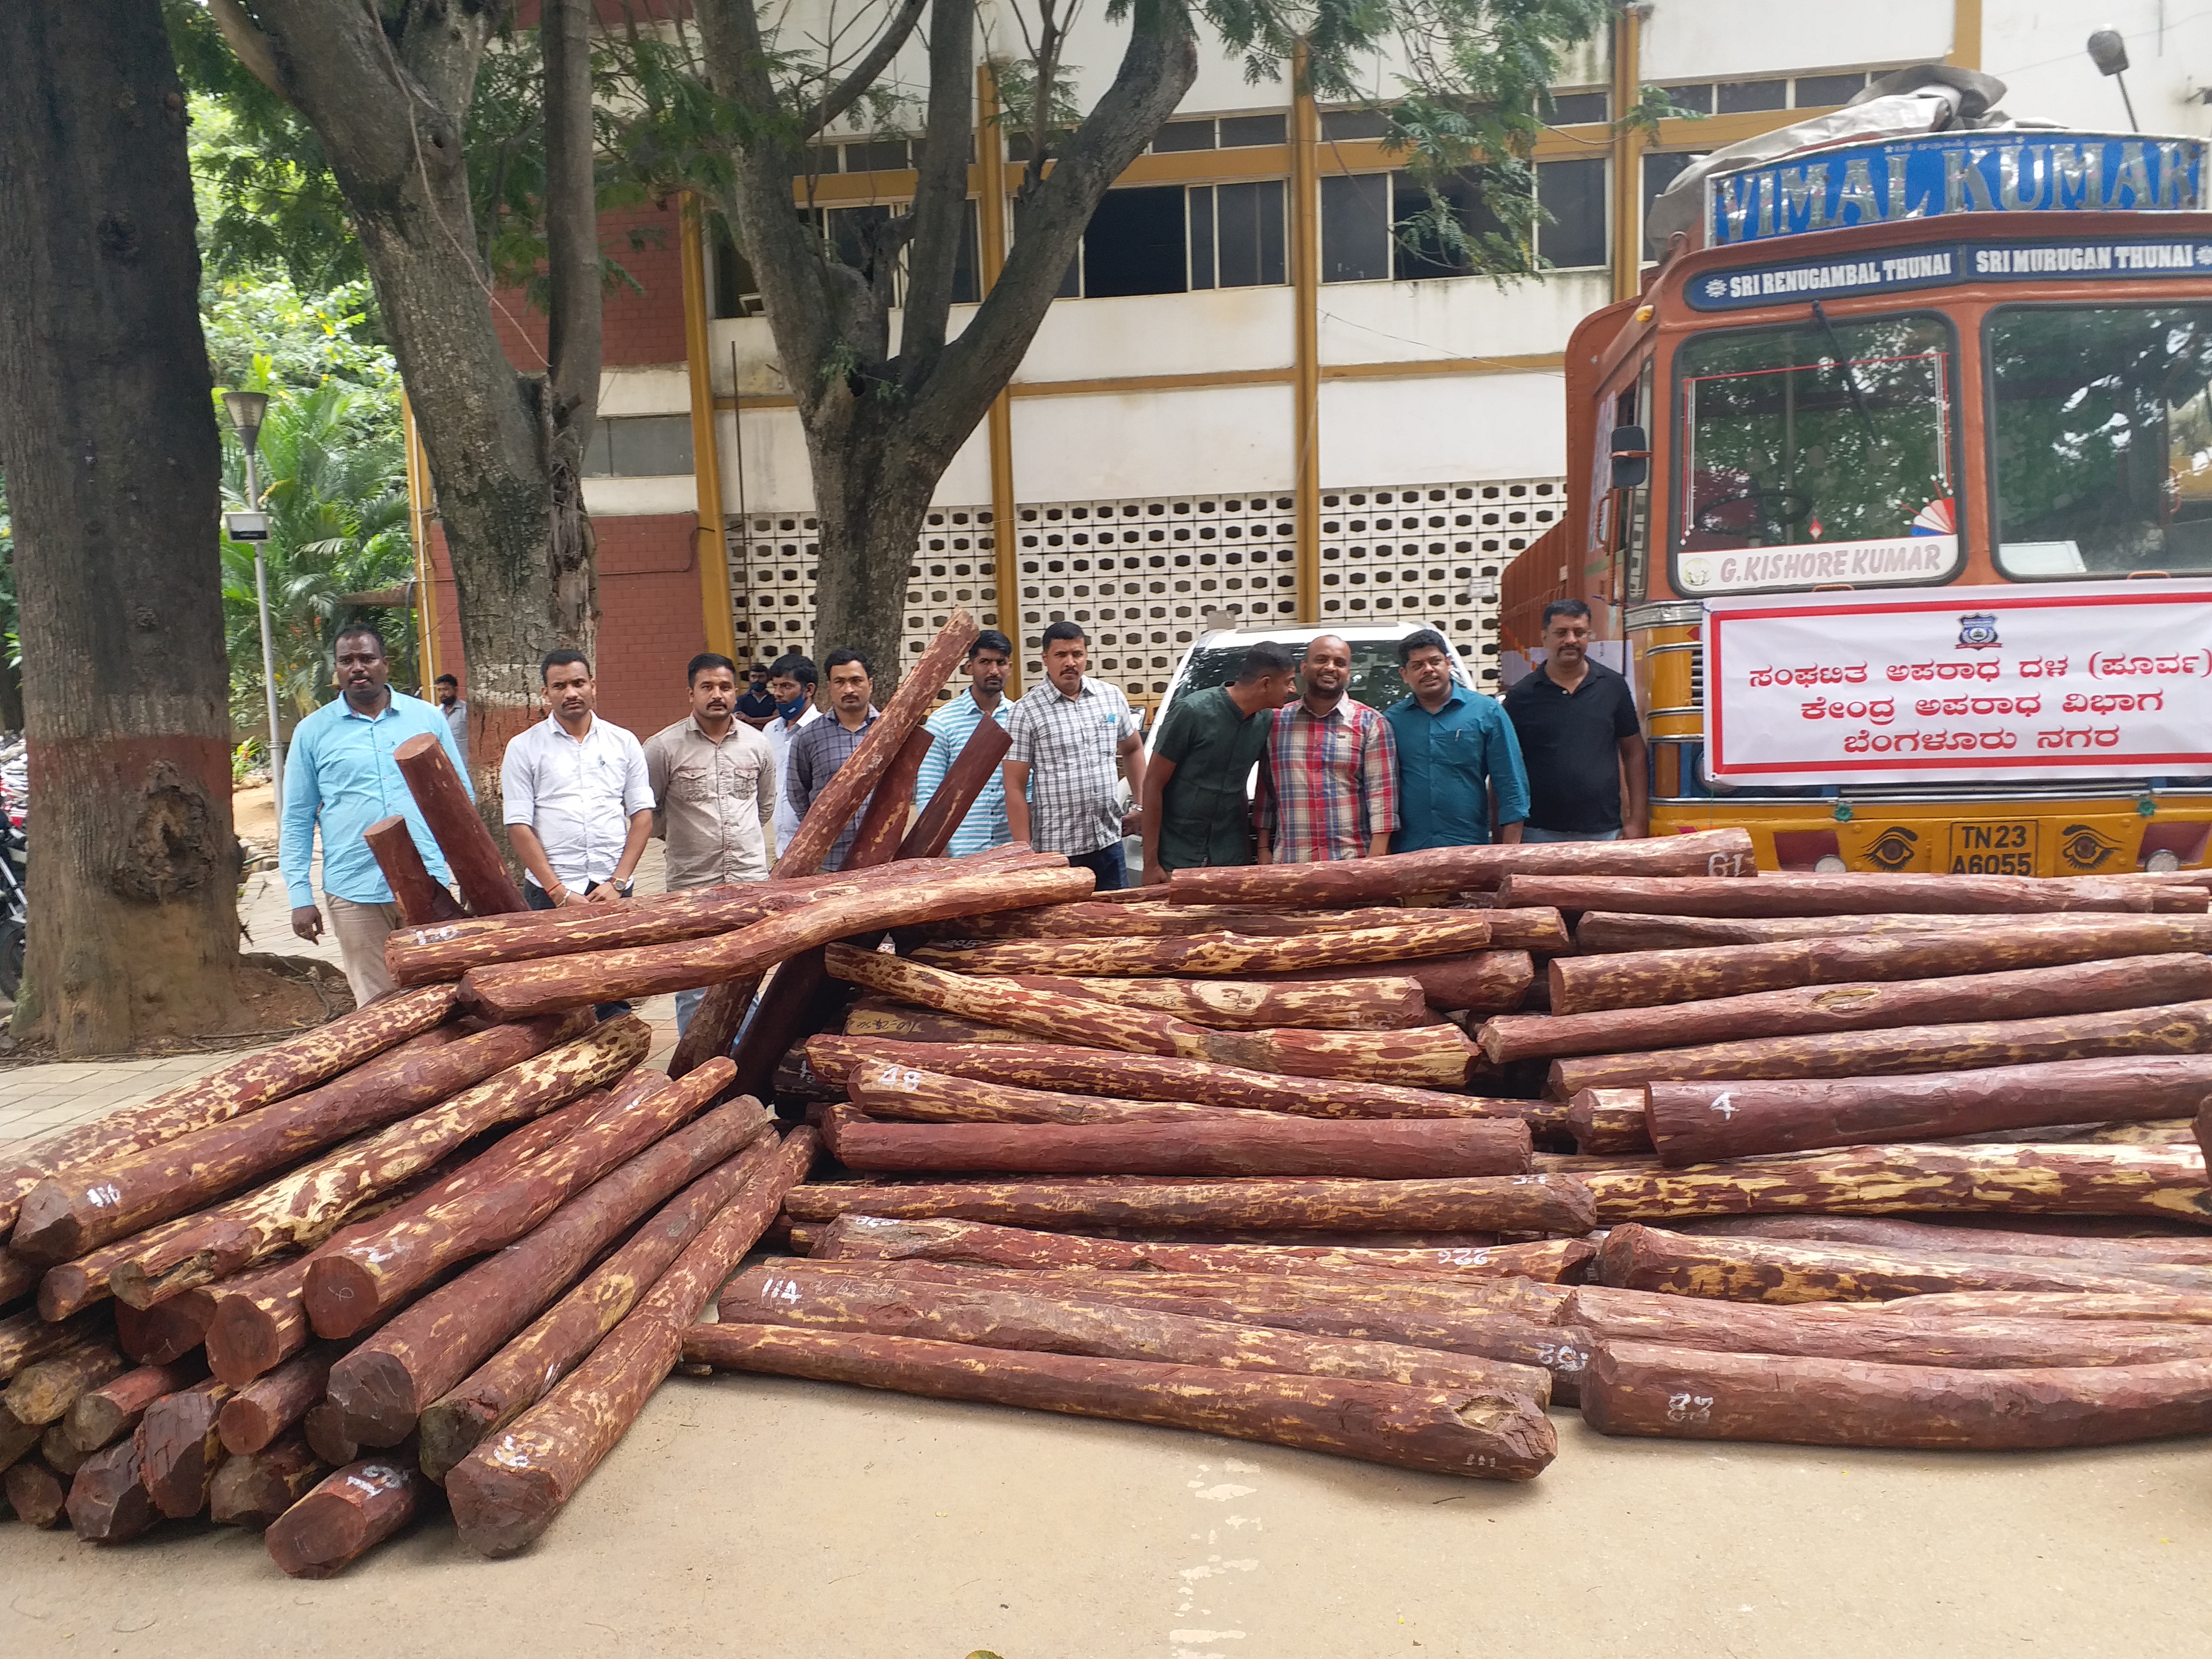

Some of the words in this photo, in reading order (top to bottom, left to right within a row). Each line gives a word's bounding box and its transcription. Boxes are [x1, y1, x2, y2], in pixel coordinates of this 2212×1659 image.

[1719, 154, 1930, 241] VIMAL
[1941, 143, 2199, 214] KUMAR
[1730, 274, 1761, 298] SRI
[1762, 262, 1881, 294] RENUGAMBAL
[1882, 253, 1951, 282] THUNAI
[1975, 250, 2011, 274] SRI
[2012, 246, 2112, 273] MURUGAN
[2114, 244, 2194, 269] THUNAI
[1851, 543, 1941, 576] KUMAR
[1749, 661, 1868, 688] ಸಂಘಟಿತ
[1886, 656, 2000, 683] ಅಪರಾಧ
[2019, 654, 2068, 678] ದಳ
[2089, 648, 2212, 680] (ಪೂರ್ವ)
[1800, 695, 1895, 725] ಕೇಂದ್ರ
[1914, 691, 2042, 718] ಅಪರಾಧ
[2062, 686, 2164, 716] ವಿಭಾಗ
[1843, 727, 2017, 754] ಬೆಂಗಳೂರು
[2036, 724, 2120, 749] ನಗರ
